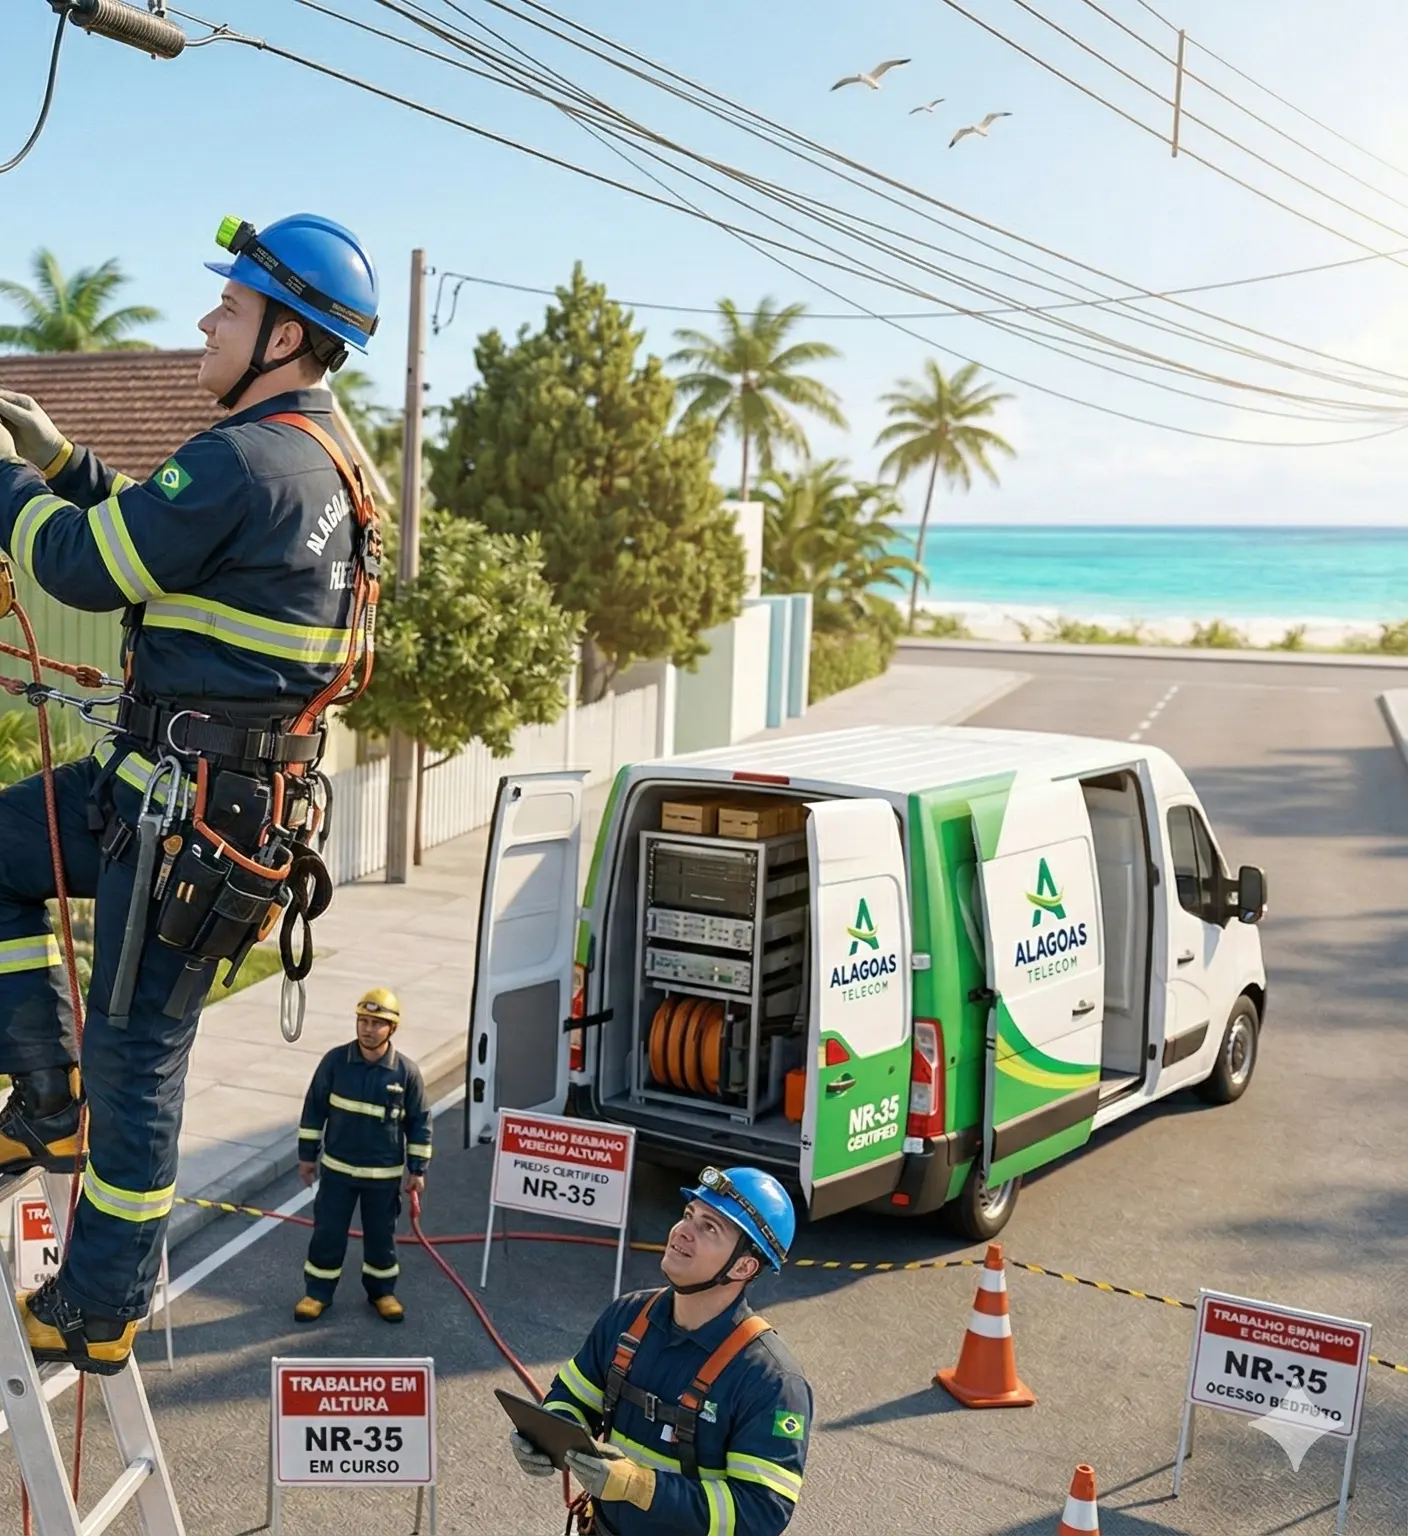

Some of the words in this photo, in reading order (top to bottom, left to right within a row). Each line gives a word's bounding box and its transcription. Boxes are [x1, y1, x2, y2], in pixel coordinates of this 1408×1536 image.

[1015, 923, 1087, 967] ALAGOAS
[830, 954, 897, 988] ALAGOAS
[1027, 956, 1078, 983] TELECOM
[842, 981, 889, 1002] TELECOM
[849, 1094, 899, 1135] NR-35
[506, 1123, 569, 1143] TRABALHO
[567, 1147, 612, 1164] ALTURA
[522, 1176, 596, 1206] NR-35
[1213, 1308, 1285, 1333] TRABALHO
[1240, 1327, 1249, 1338] E
[289, 1376, 386, 1392] TRABALHO
[391, 1376, 417, 1392] EM
[1224, 1350, 1328, 1395] NR-35
[318, 1397, 389, 1412] ALTURA
[305, 1425, 403, 1452] NR-35
[309, 1460, 334, 1473] EM
[340, 1460, 400, 1473] CURSO
